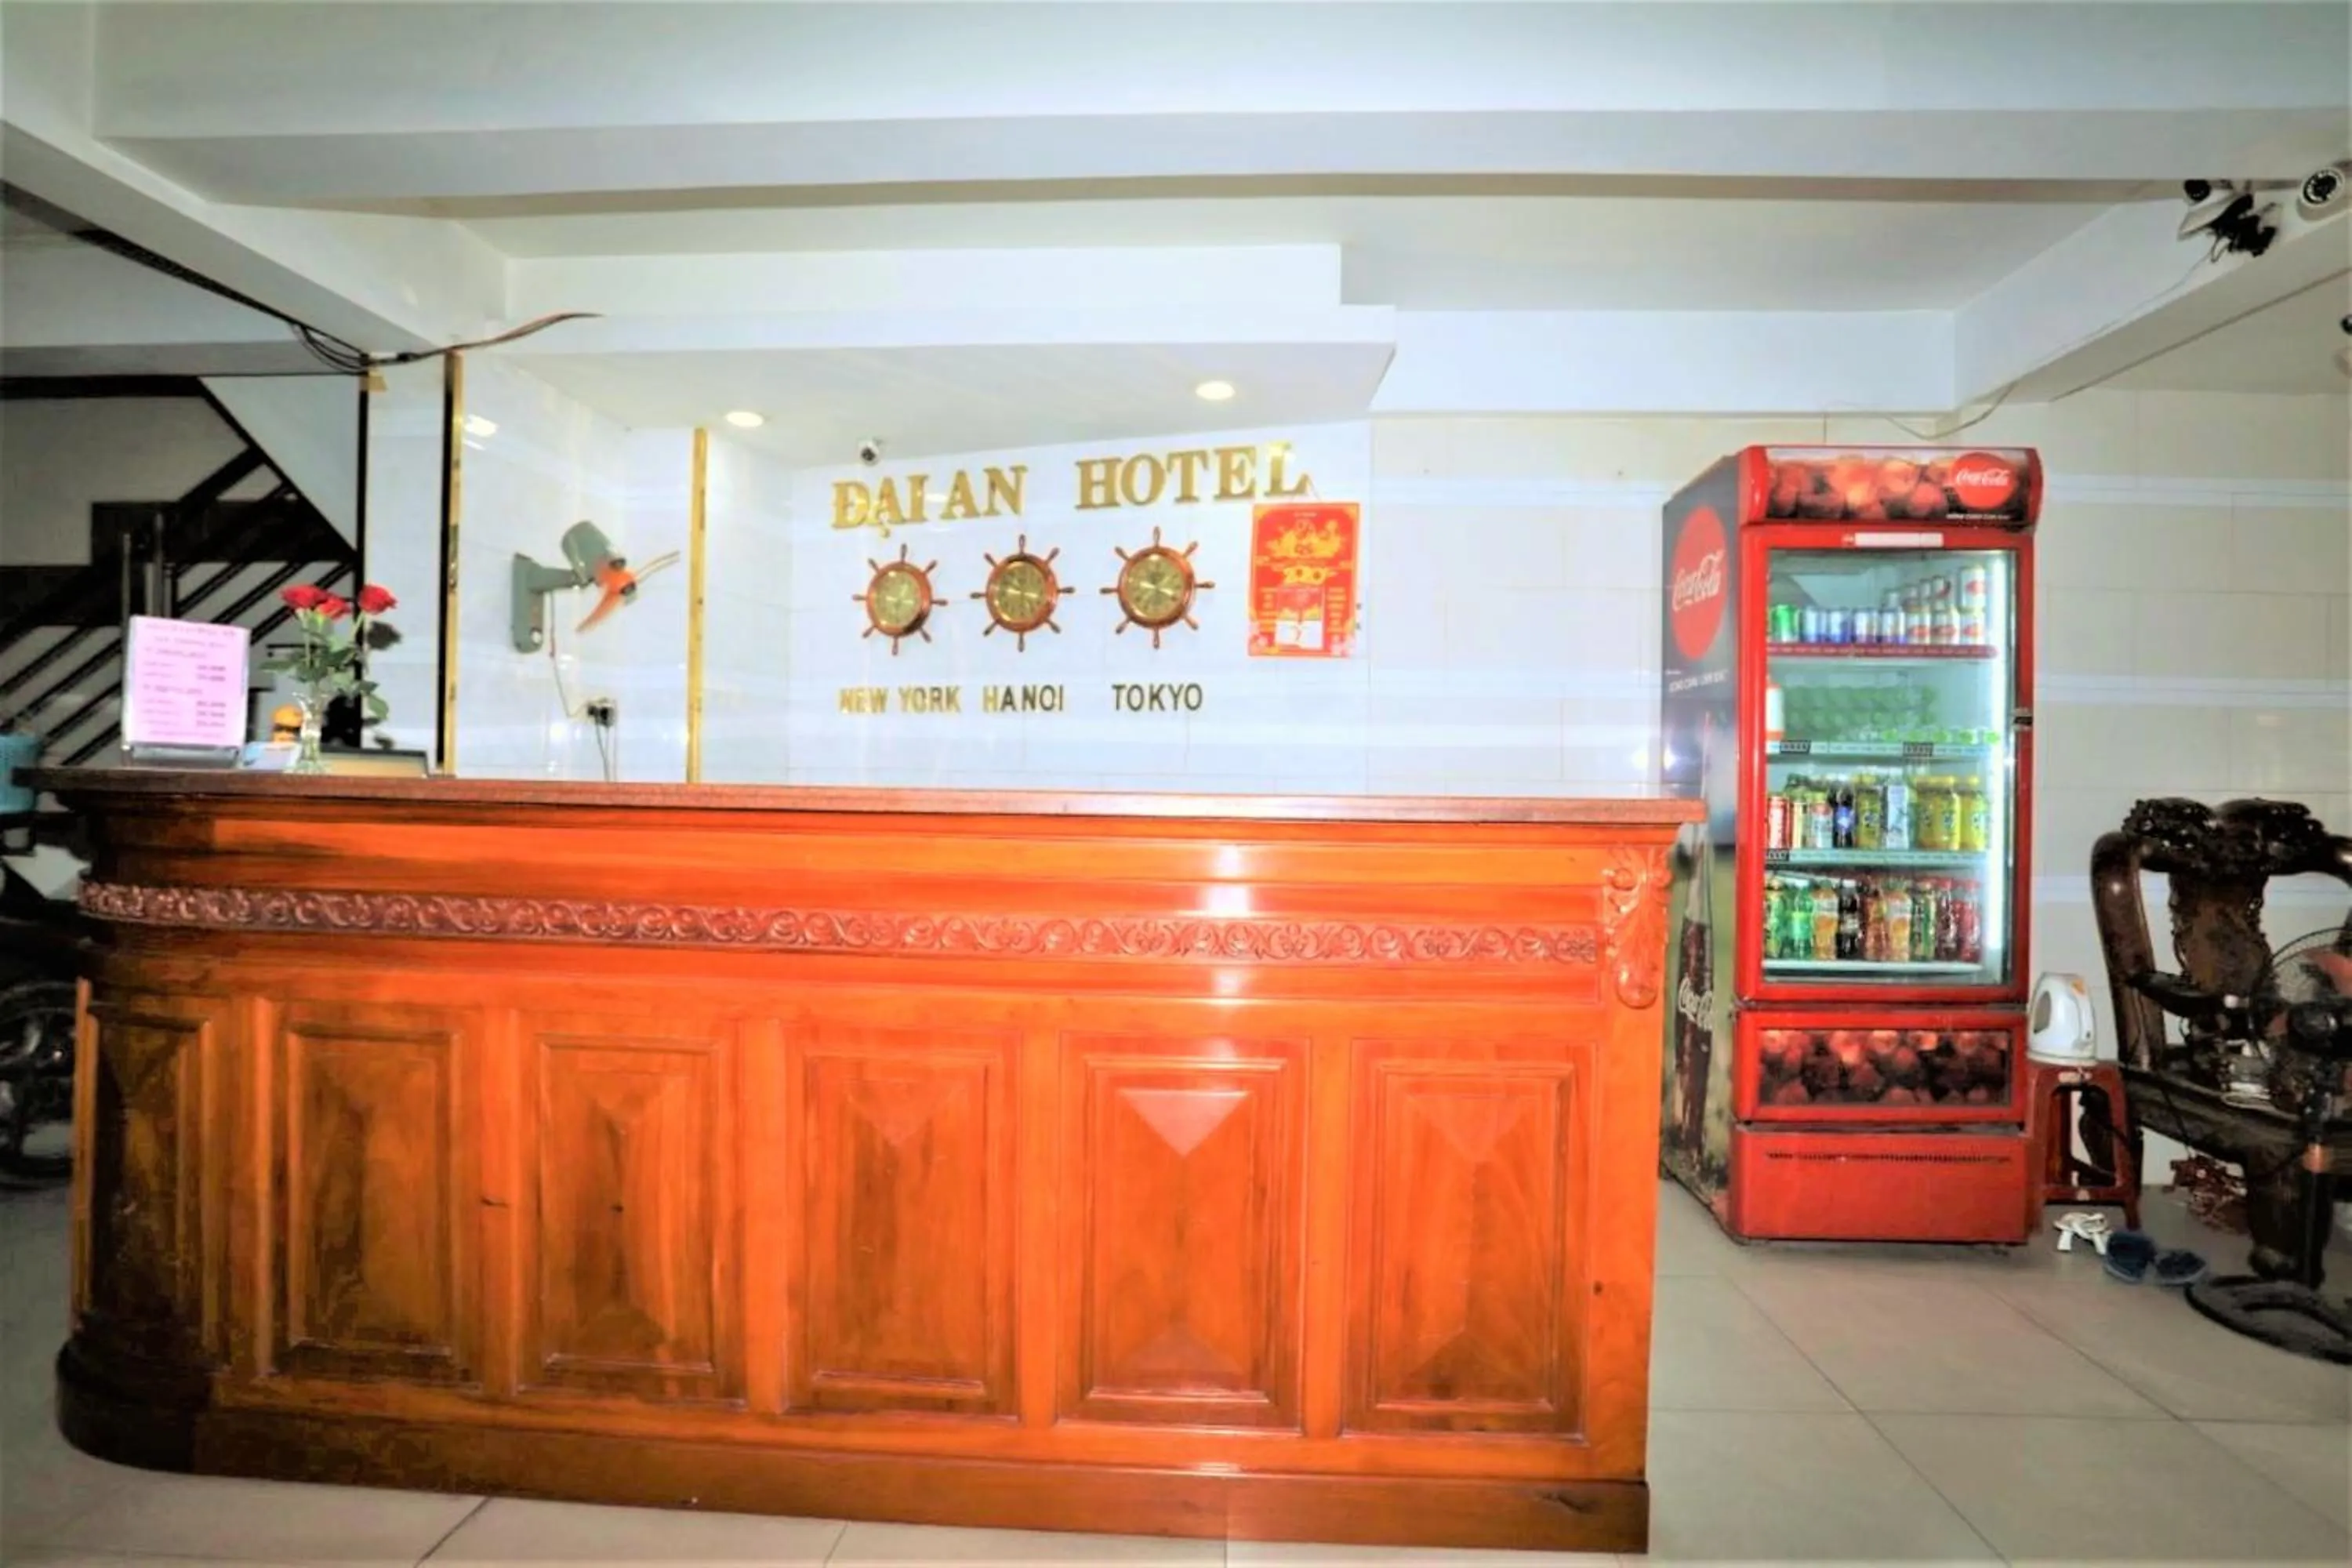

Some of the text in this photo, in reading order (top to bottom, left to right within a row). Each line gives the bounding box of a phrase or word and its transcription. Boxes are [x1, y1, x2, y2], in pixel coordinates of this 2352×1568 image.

[939, 465, 1029, 520] AN
[1075, 441, 1308, 510] HOTEL
[1672, 549, 1725, 612] Coca-Cola
[839, 684, 962, 713] NEW YORK
[982, 684, 1064, 713] HANOI
[1111, 682, 1203, 712] TOKYO
